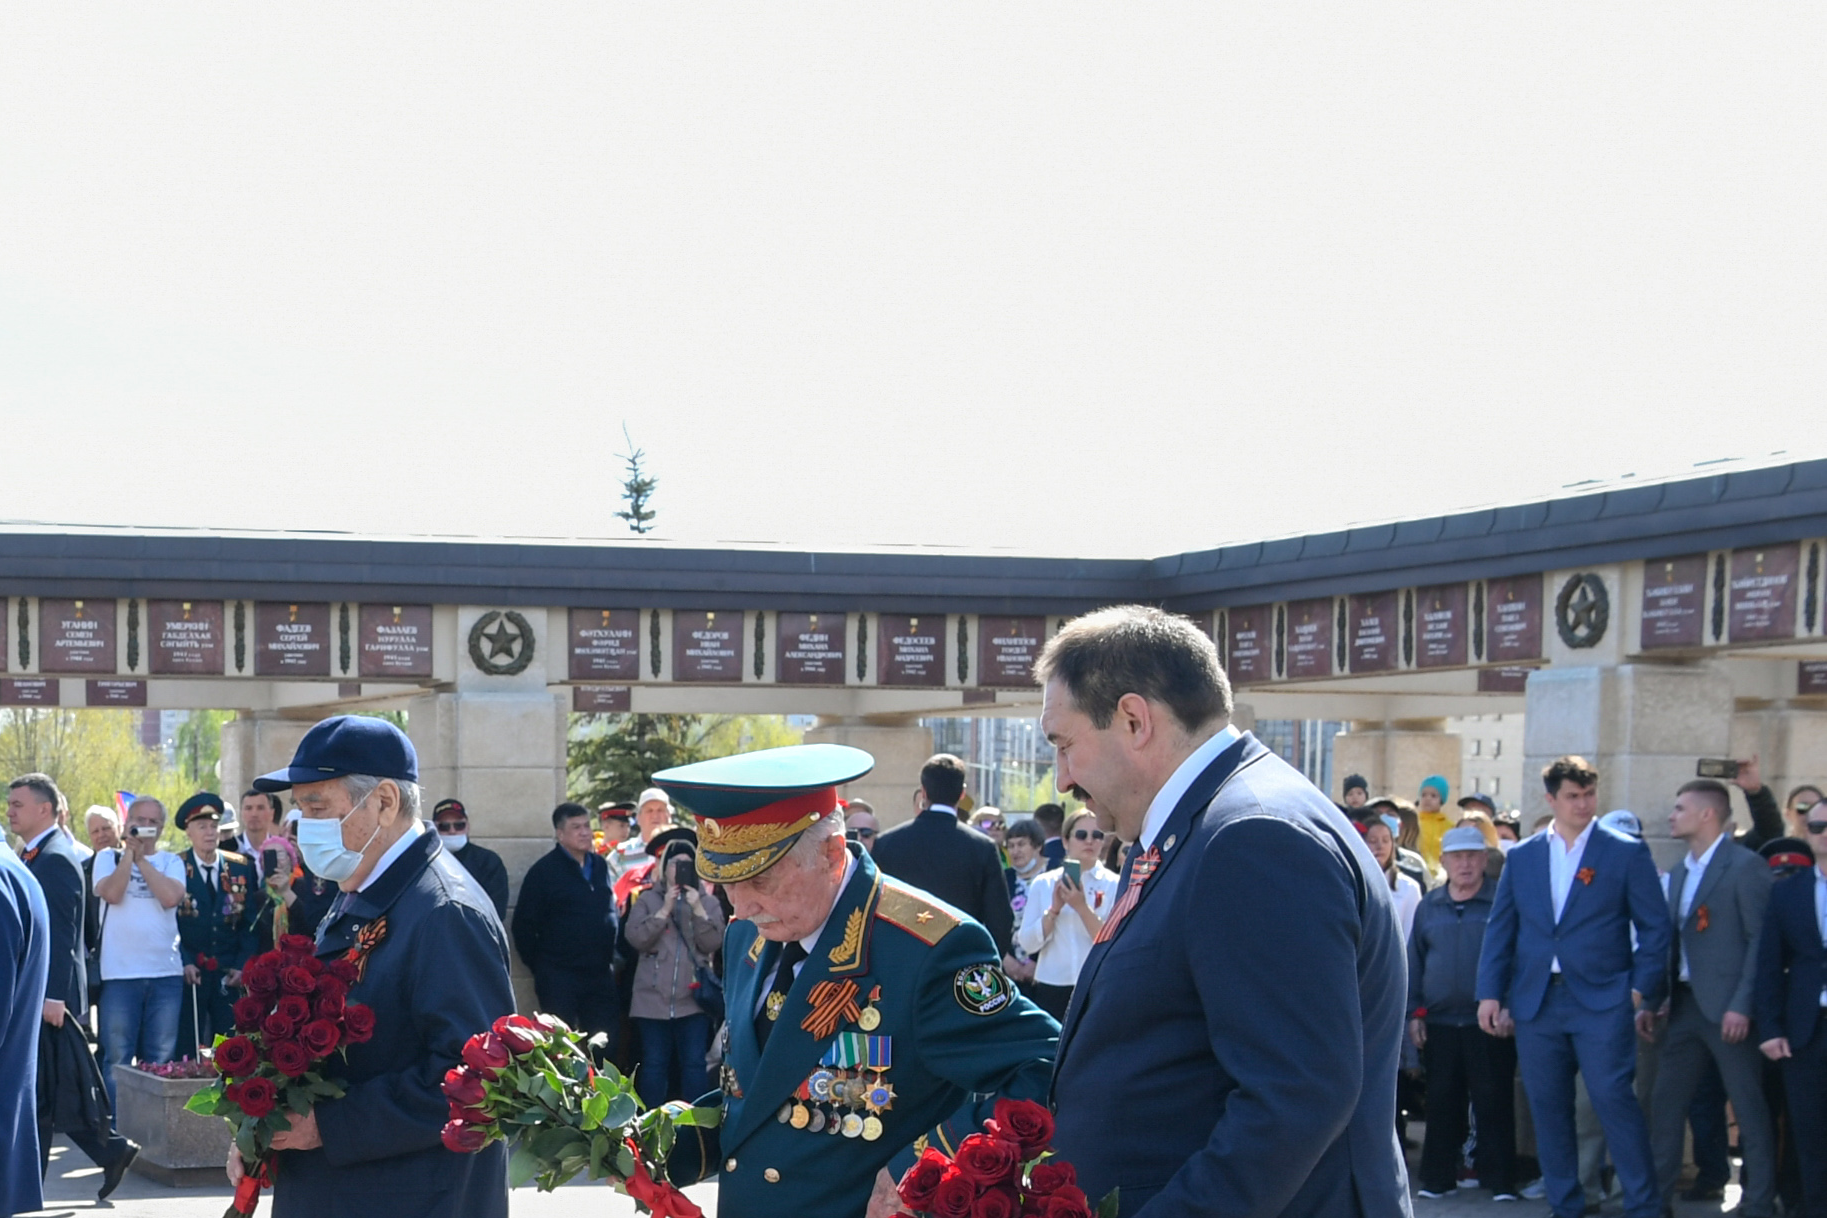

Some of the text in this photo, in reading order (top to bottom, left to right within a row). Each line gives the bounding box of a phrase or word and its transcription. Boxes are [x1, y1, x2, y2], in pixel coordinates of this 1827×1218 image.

[276, 624, 311, 633] ФАДЕЕВ
[378, 635, 416, 644] НУРУЛЛА
[365, 644, 414, 652] ГАРИФУЛЛА
[979, 993, 1007, 1013] РОССИЯ
